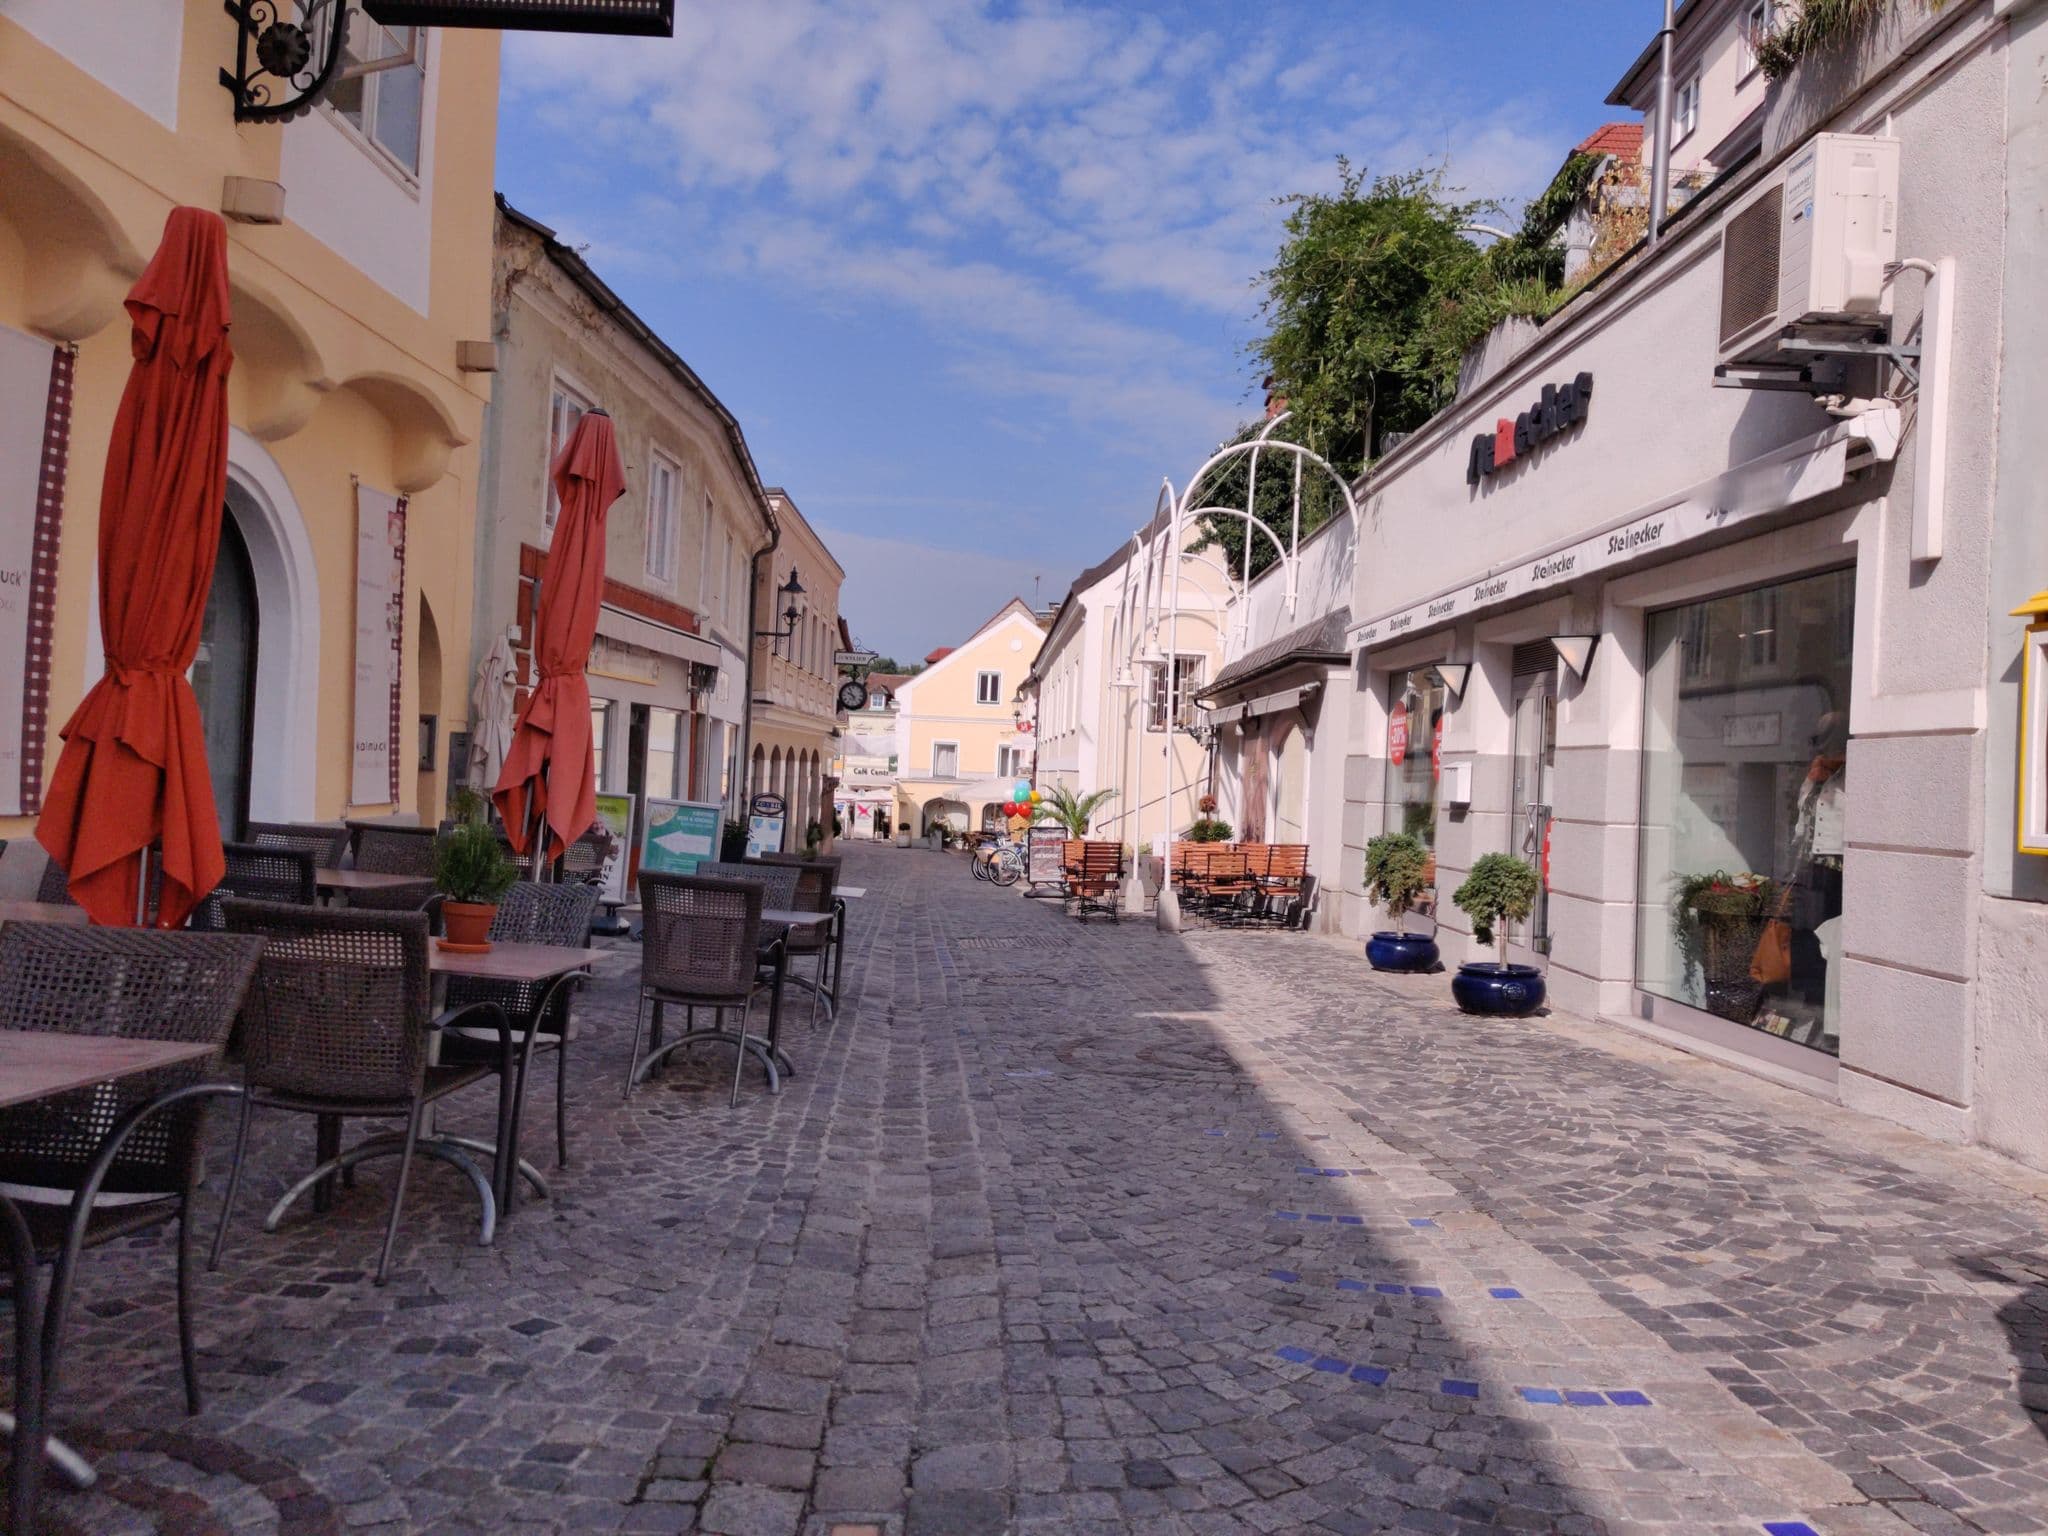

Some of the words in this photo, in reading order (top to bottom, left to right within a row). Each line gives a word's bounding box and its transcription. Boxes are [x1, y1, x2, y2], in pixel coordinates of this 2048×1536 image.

[1608, 522, 1664, 556] Steinecker
[1531, 554, 1576, 582] Steinecker
[1473, 580, 1508, 601] Steinecker
[1428, 599, 1456, 618] Steinecker
